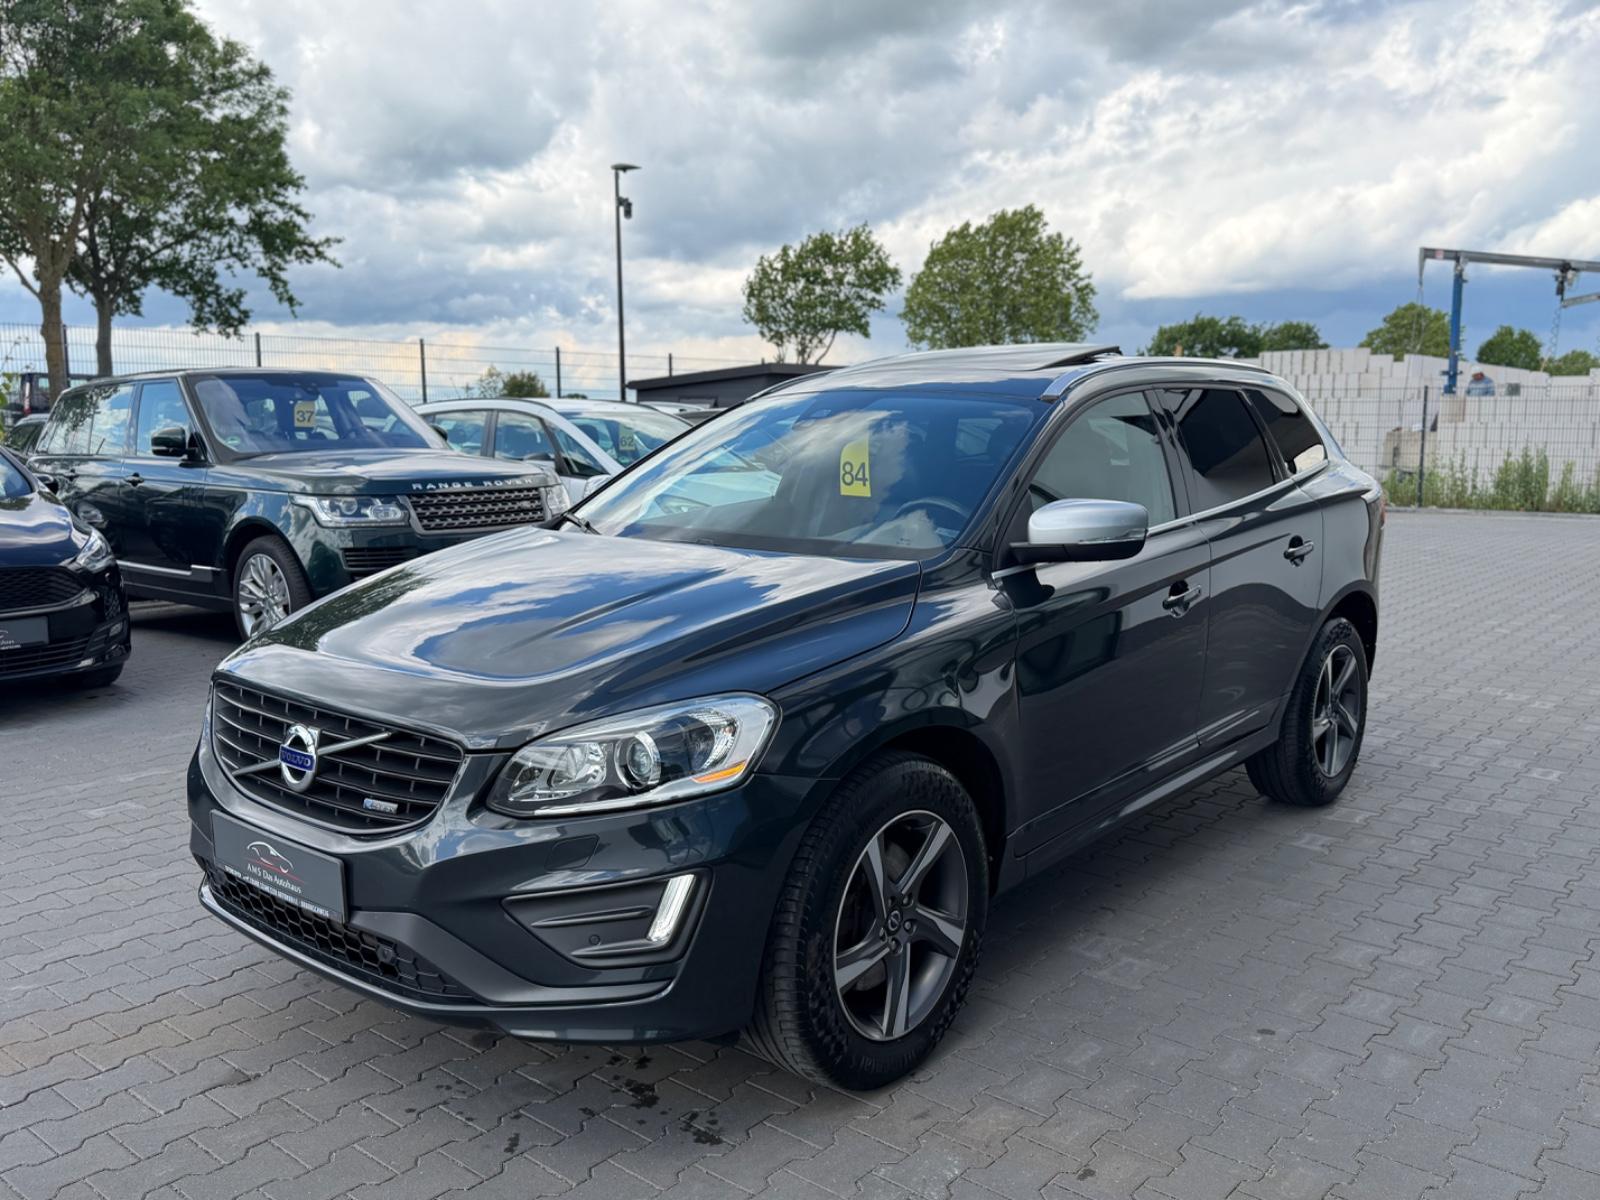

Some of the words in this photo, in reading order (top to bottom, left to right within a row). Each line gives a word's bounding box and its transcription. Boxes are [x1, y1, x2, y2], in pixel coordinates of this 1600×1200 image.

[296, 410, 314, 423] 37
[620, 436, 634, 447] 62
[841, 461, 869, 487] 84
[411, 481, 473, 490] RANGE
[482, 479, 533, 487] ROVER
[281, 750, 311, 766] VOLVO
